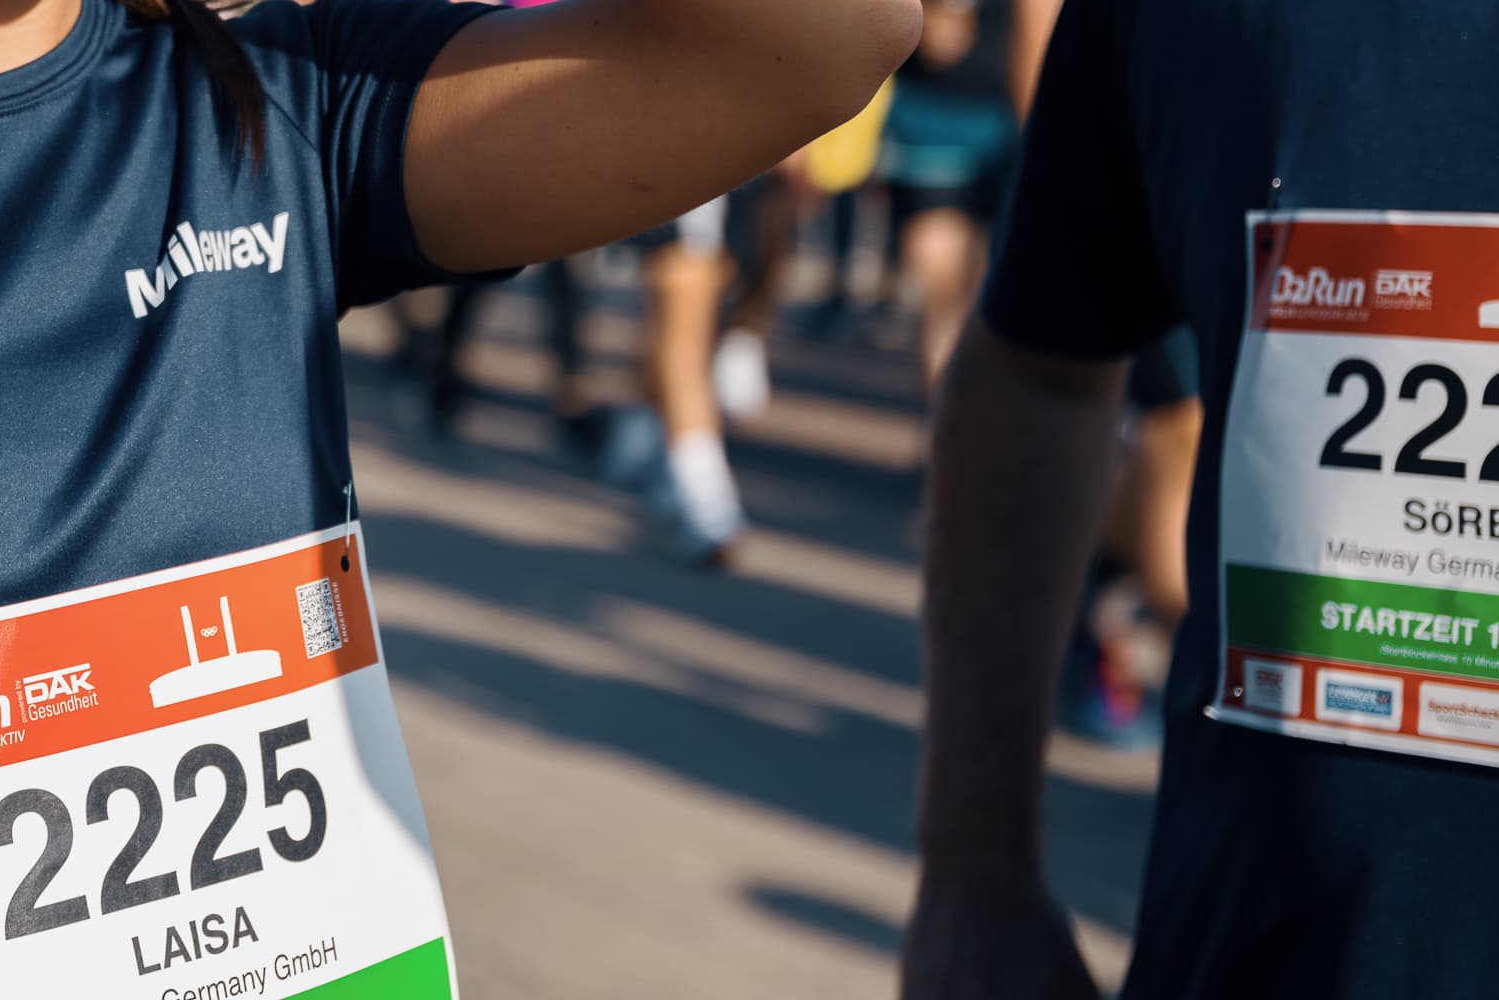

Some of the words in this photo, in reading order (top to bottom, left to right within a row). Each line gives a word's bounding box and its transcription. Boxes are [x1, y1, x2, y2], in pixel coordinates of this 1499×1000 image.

[124, 211, 289, 319] Mileway
[1375, 269, 1433, 297] DAK
[1325, 539, 1419, 575] Mileway
[1321, 601, 1479, 646] STARTZEIT
[22, 663, 96, 704] DAK
[27, 692, 99, 721] Gesundheit
[131, 906, 259, 976] LAISA
[161, 966, 267, 1000] Germany
[274, 937, 338, 980] GmbH
